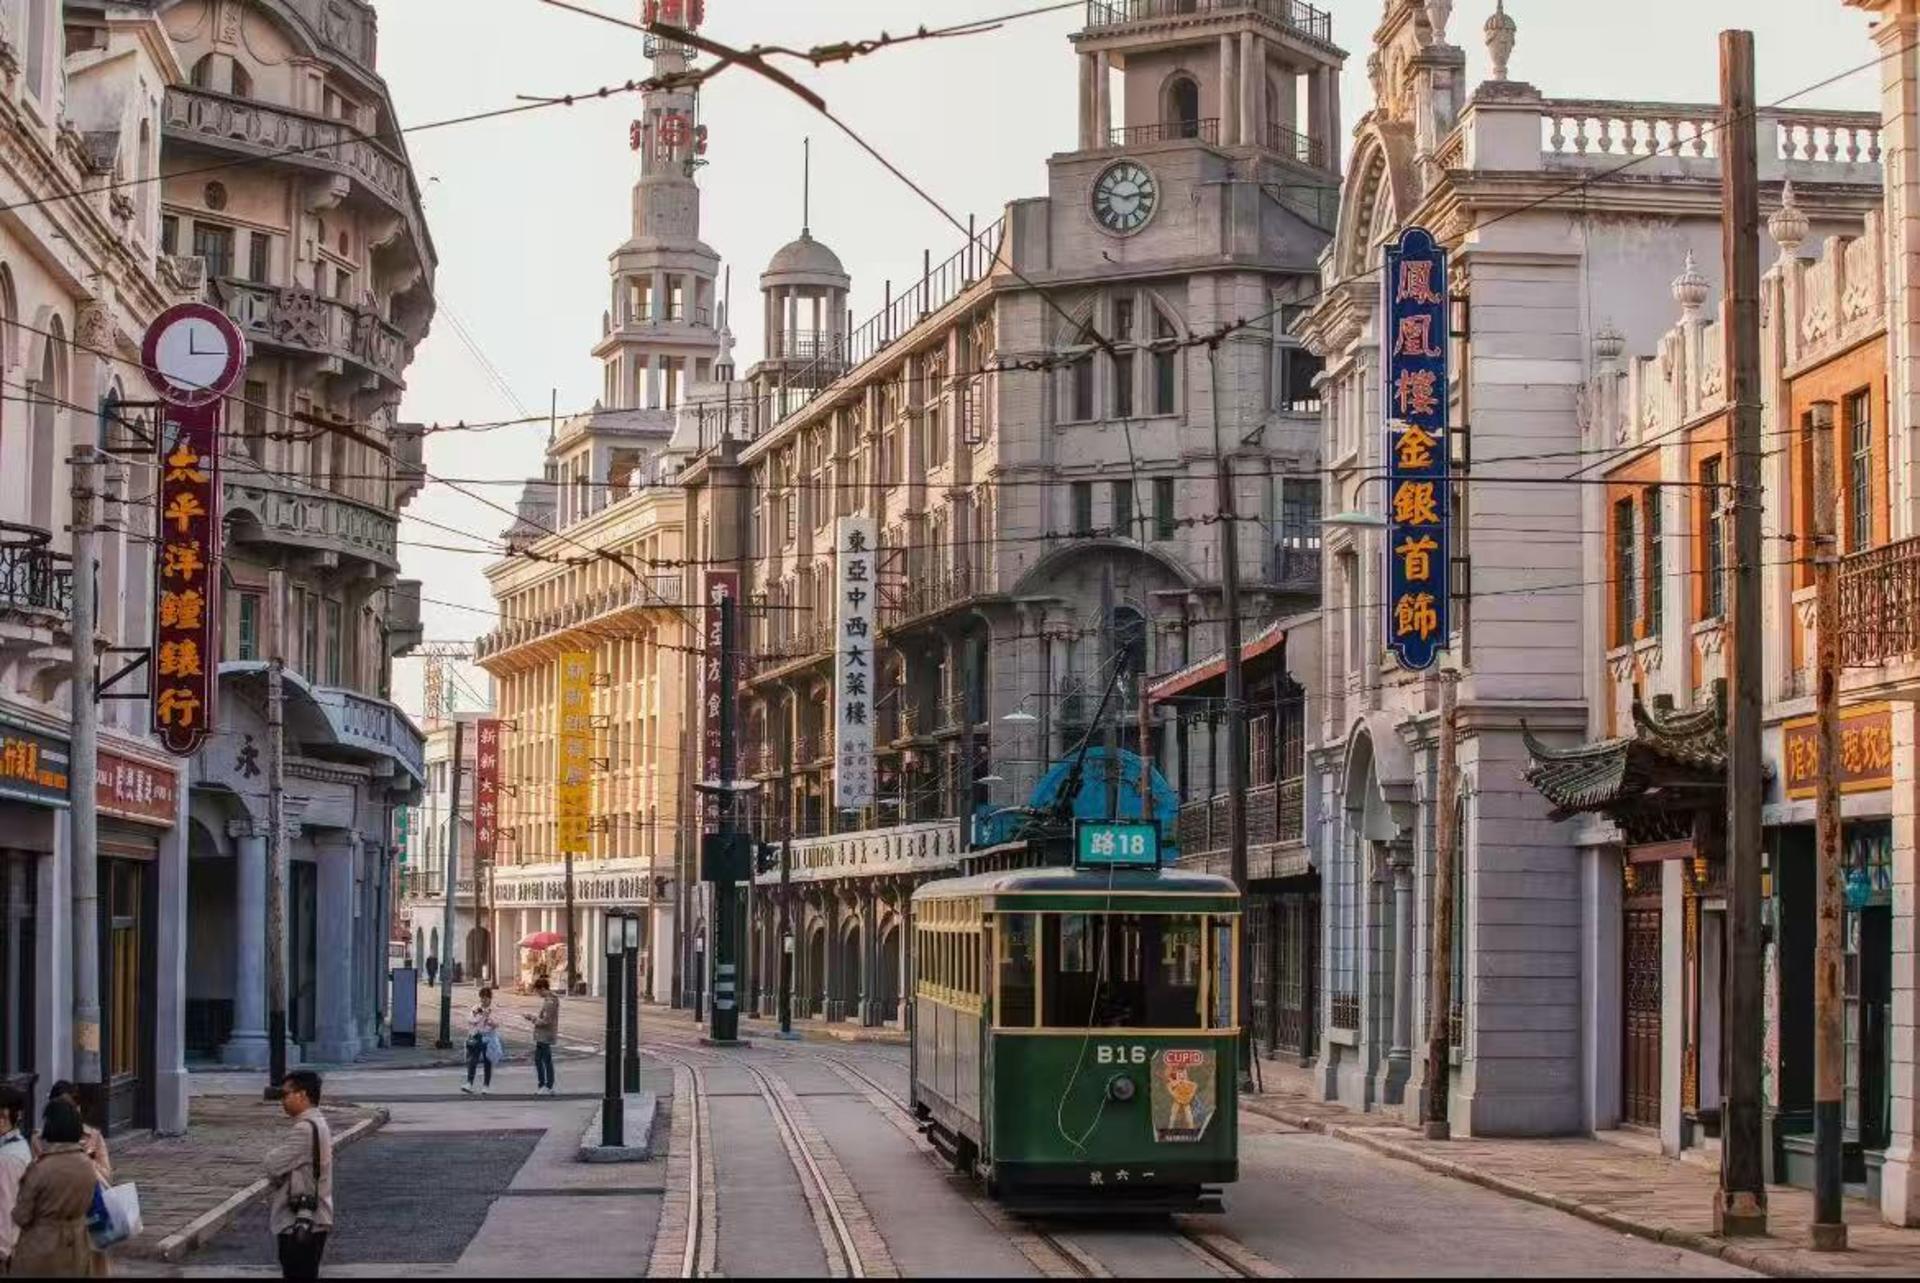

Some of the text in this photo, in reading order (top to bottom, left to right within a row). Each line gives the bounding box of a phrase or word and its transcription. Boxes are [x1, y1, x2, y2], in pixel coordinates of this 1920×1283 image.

[1393, 259, 1442, 642] 鳳凰樓金銀首飾
[845, 529, 869, 726] 東亞中西大菜樓
[1097, 1045, 1147, 1064] B16
[1165, 1052, 1202, 1064] CUPID
